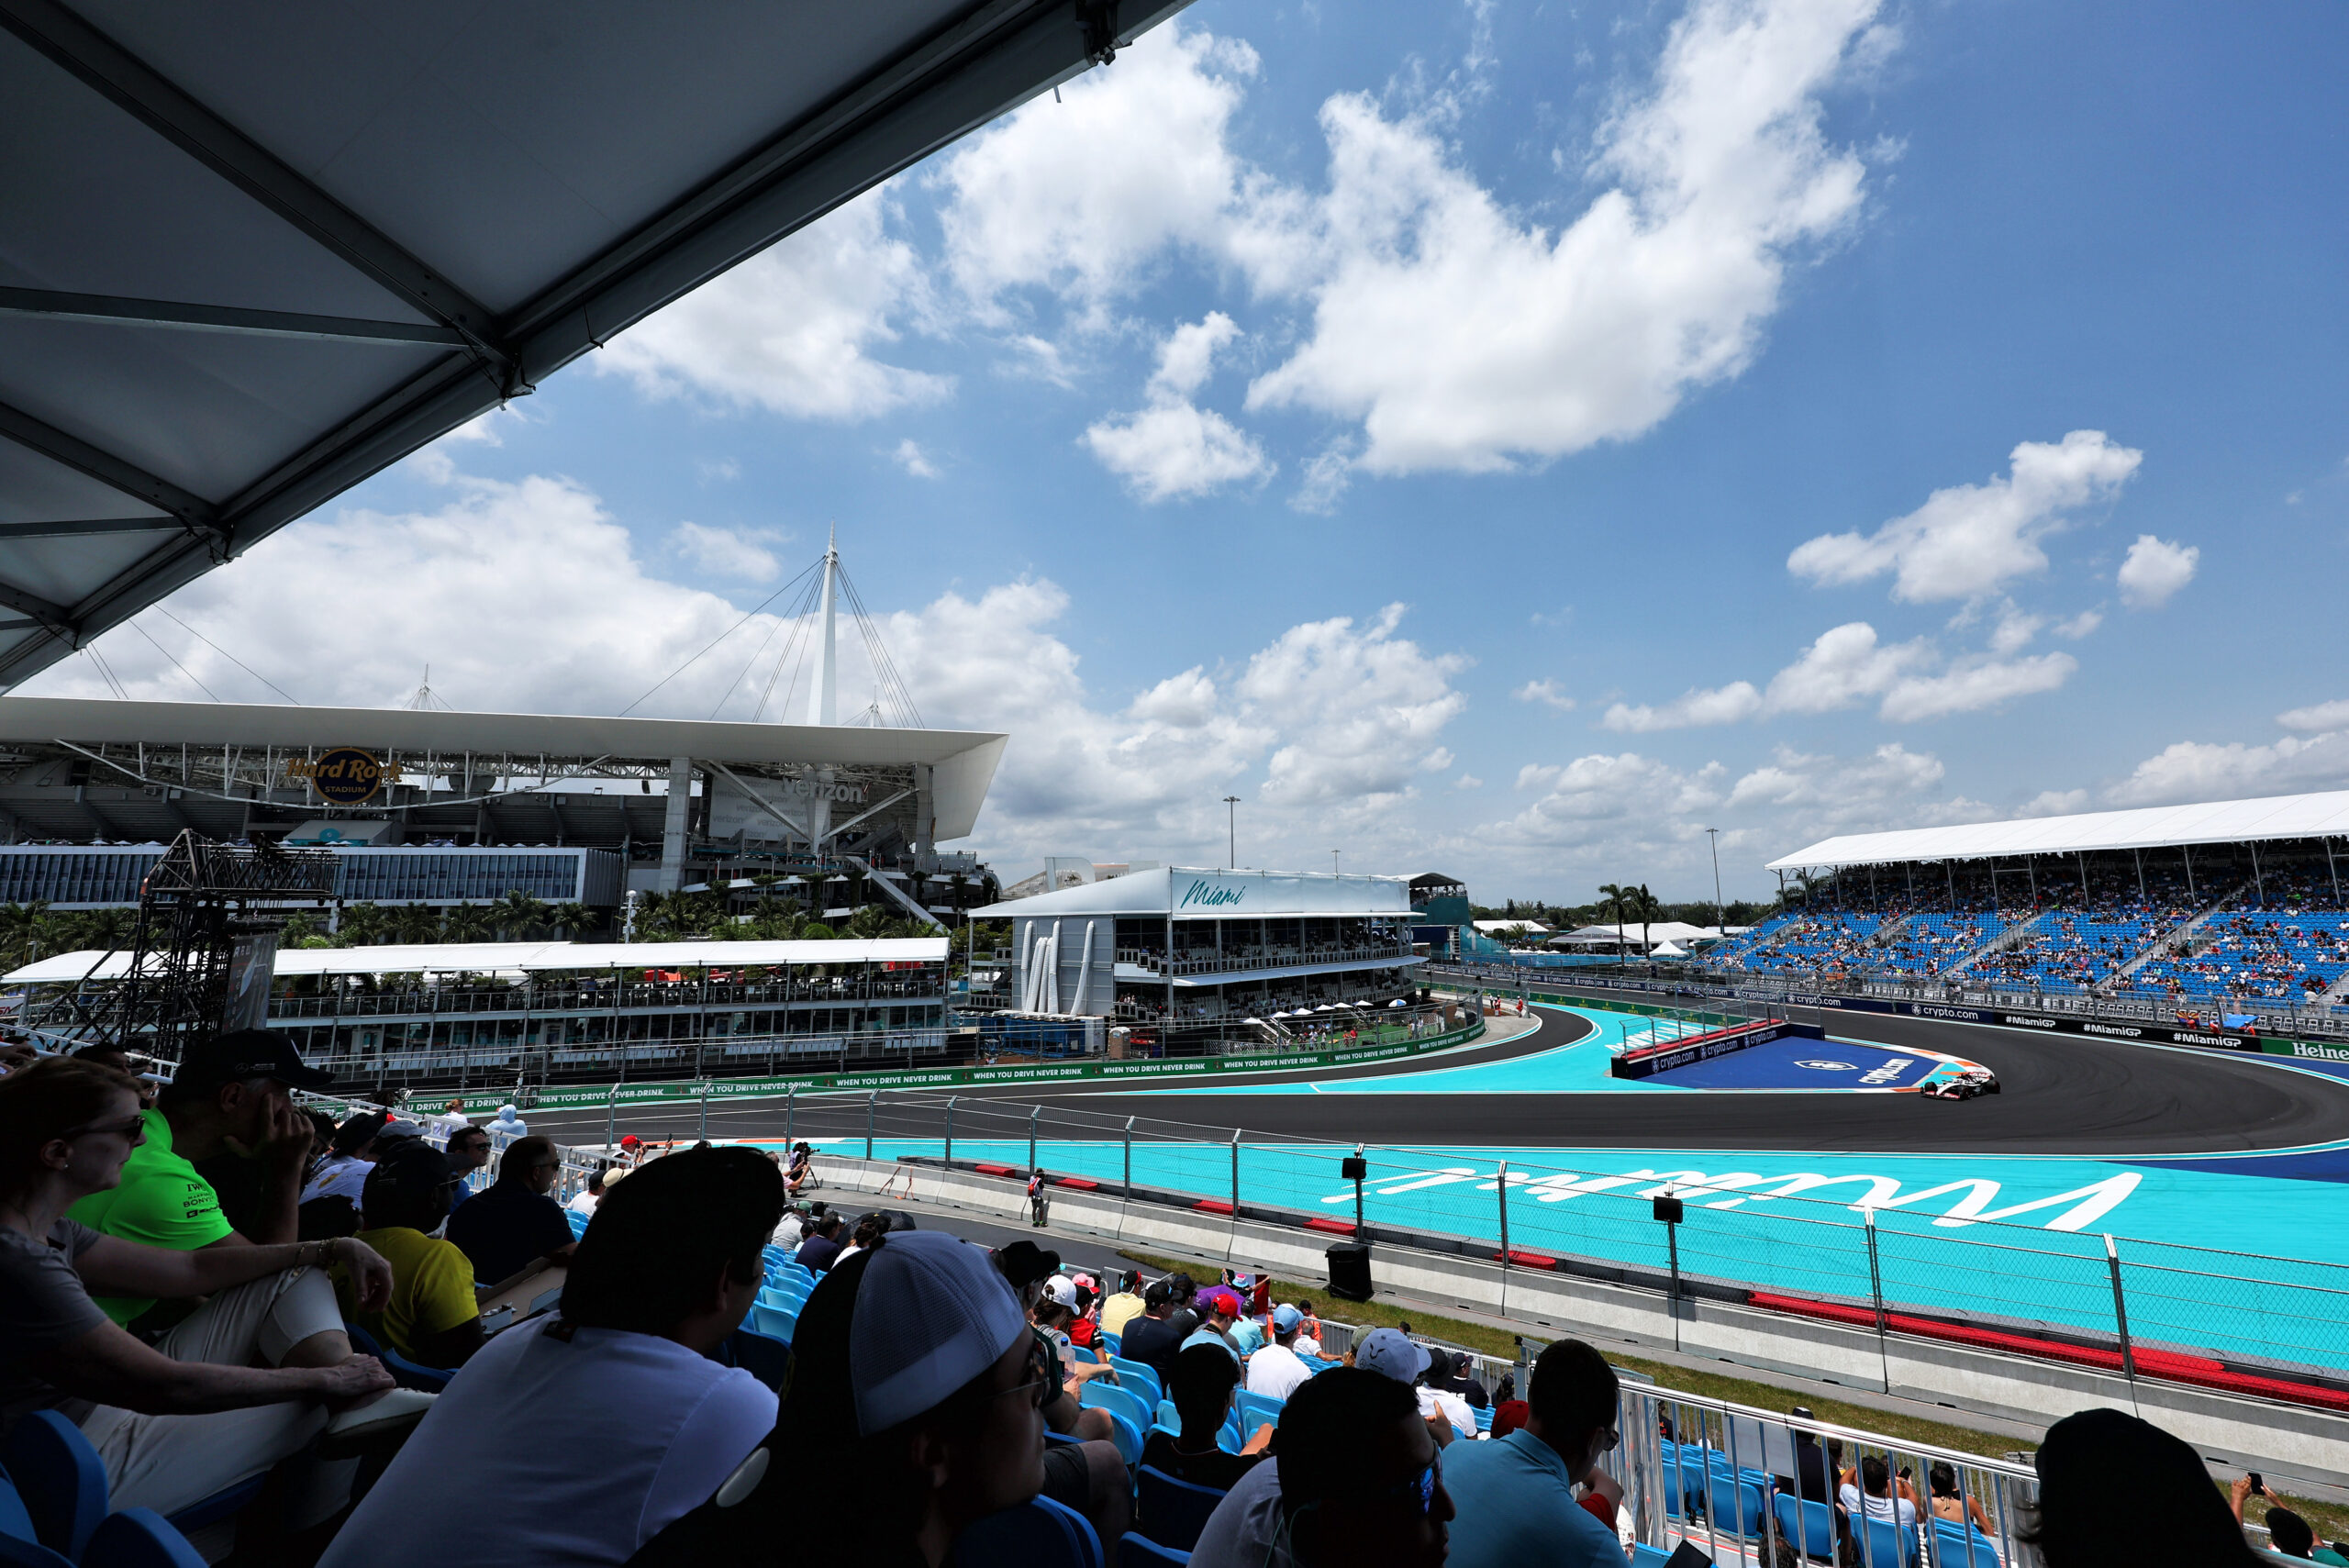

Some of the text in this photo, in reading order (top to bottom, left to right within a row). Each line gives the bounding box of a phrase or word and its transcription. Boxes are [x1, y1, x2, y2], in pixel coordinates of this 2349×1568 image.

[285, 758, 404, 783] Hard Rock
[783, 777, 863, 803] verizon
[1180, 879, 1246, 909] Miami
[1923, 1006, 1979, 1020] crypto.com
[2006, 1016, 2056, 1028] #MiamiGP
[1750, 1029, 1777, 1045] crypto.com
[2084, 1023, 2142, 1037] #MiamiGP
[2173, 1032, 2242, 1047] #MiamiGP
[1708, 1040, 1738, 1057] crypto.com
[1660, 1050, 1695, 1070] crypto.com
[581, 1093, 606, 1101] DRIVE
[608, 1090, 635, 1099] EVER
[637, 1088, 663, 1096] DRINK
[736, 1084, 759, 1092] DRIVE
[417, 1103, 443, 1111] DRIVE
[476, 1098, 505, 1106] DRINK
